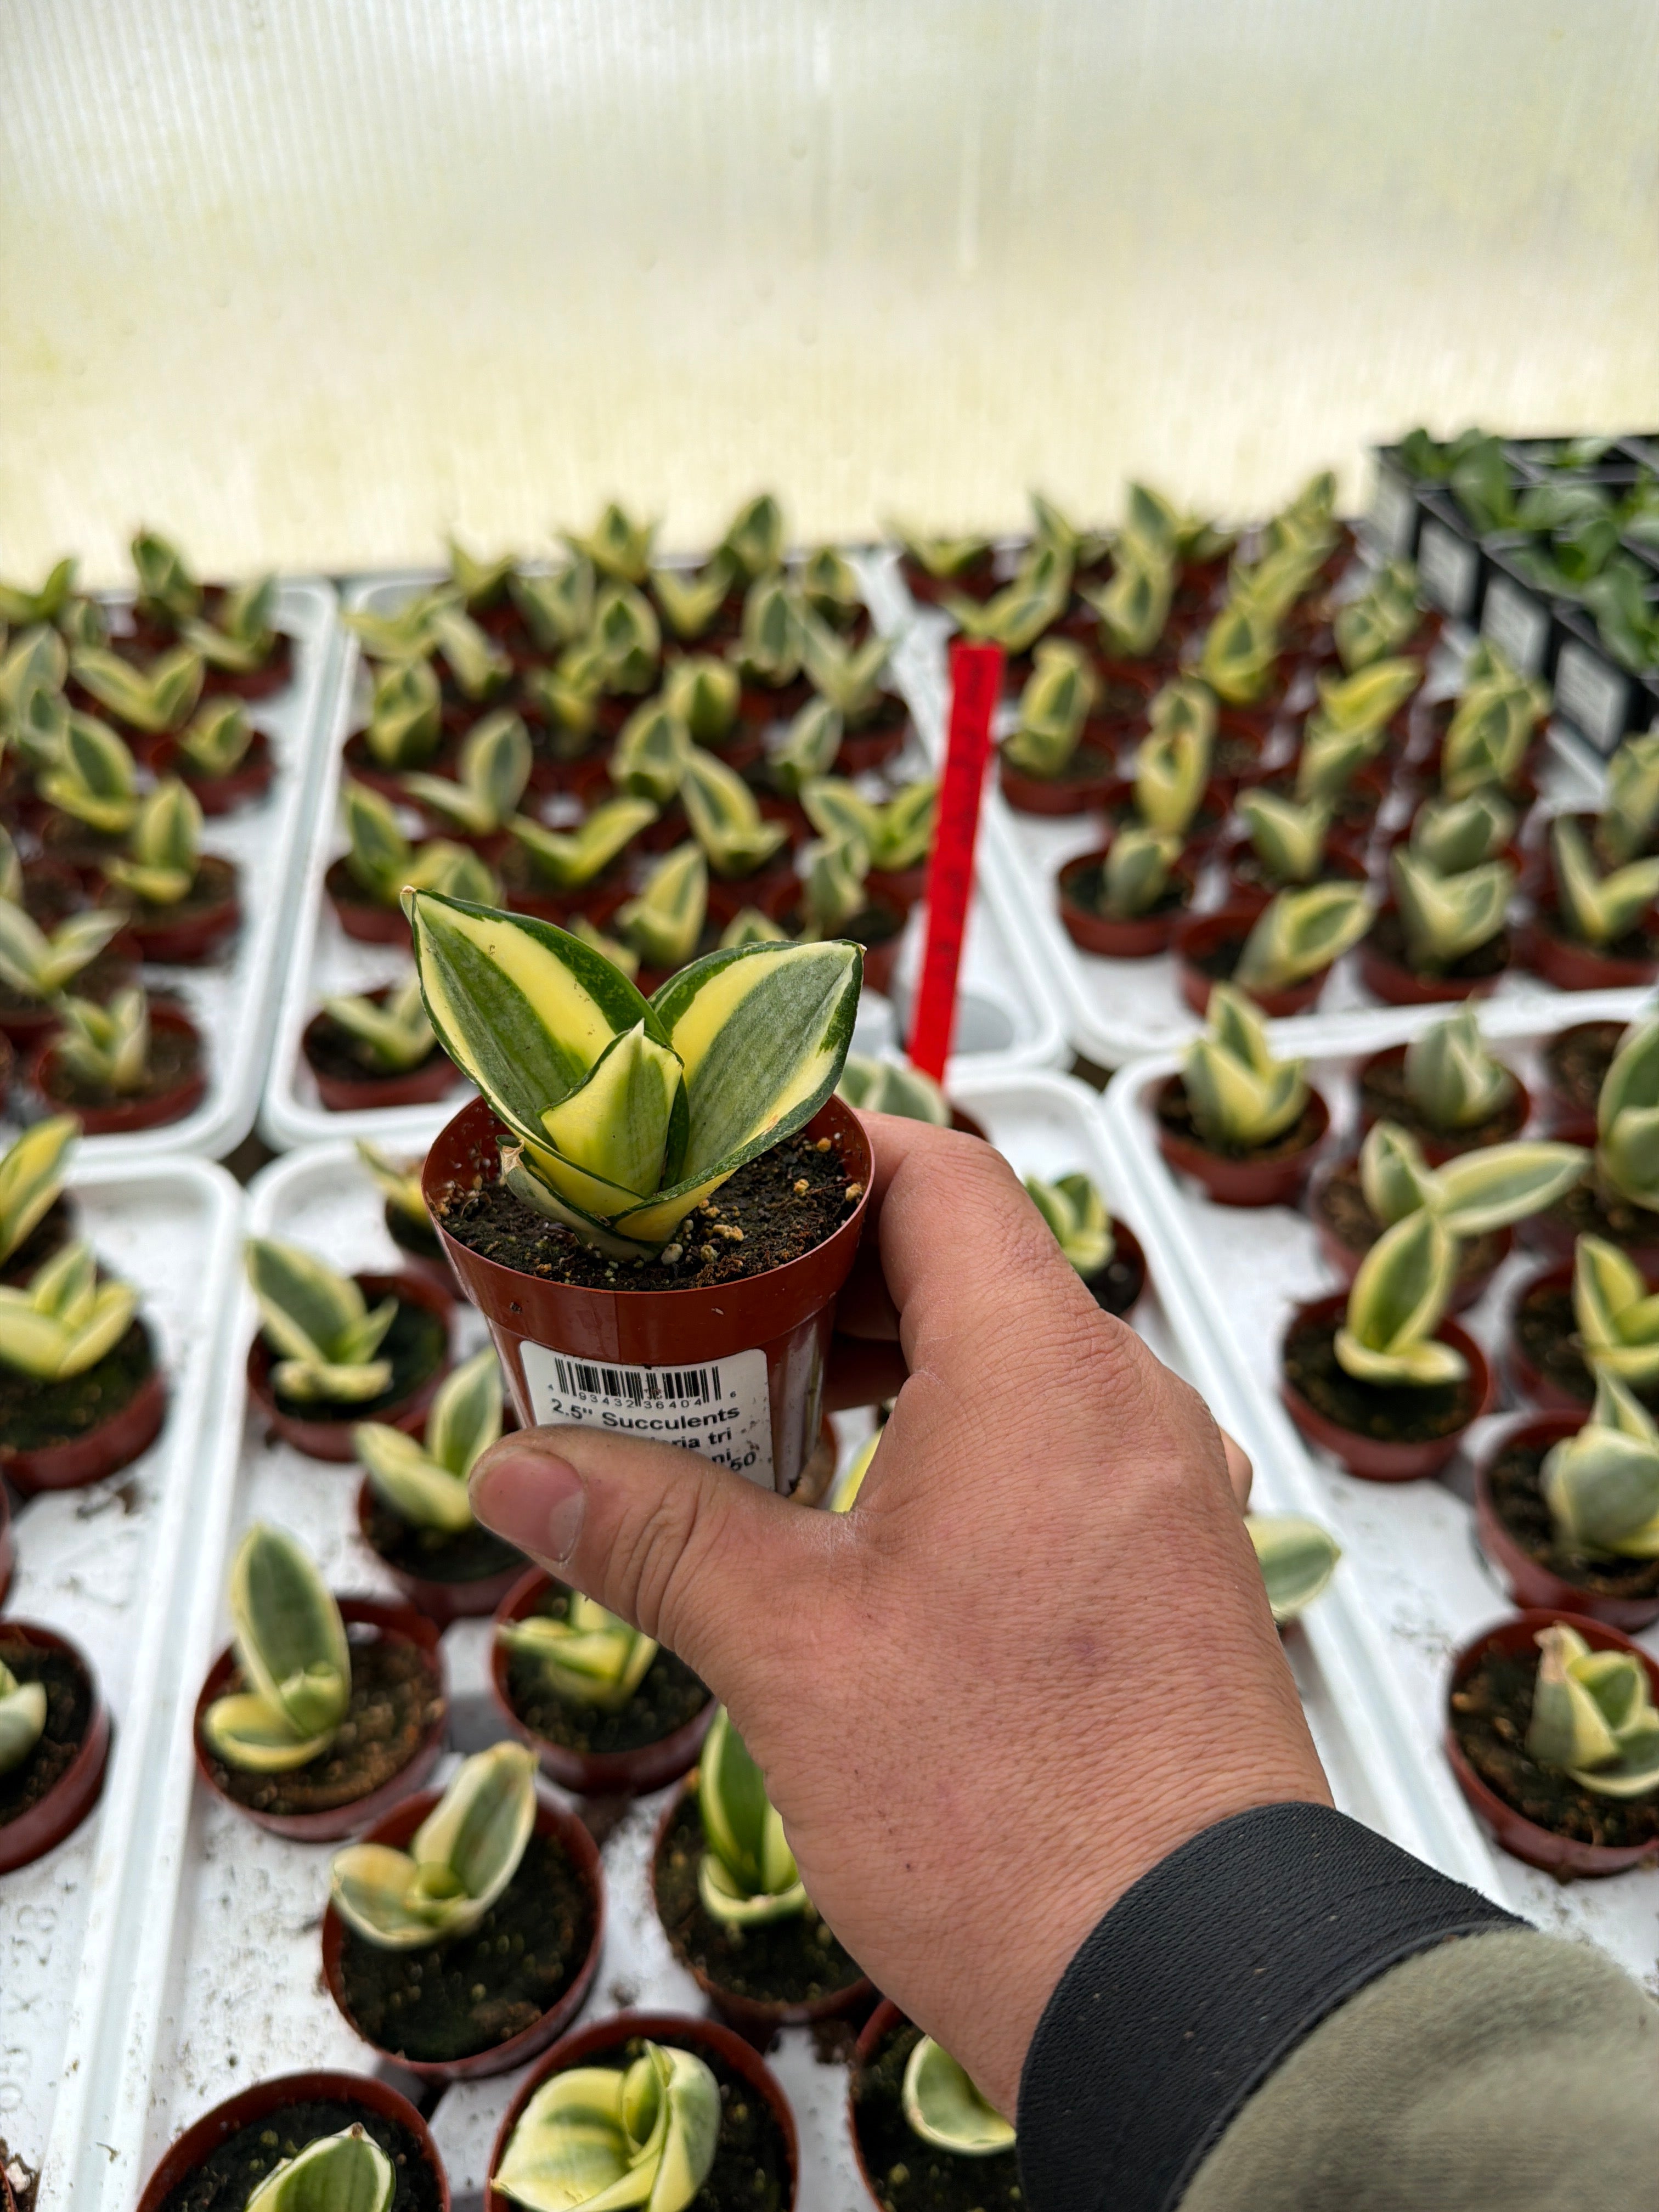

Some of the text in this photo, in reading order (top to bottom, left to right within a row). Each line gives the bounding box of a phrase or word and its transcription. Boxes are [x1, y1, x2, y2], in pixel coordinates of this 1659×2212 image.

[551, 1398, 740, 1430] 2.5" Succulents
[708, 1427, 732, 1444] tri
